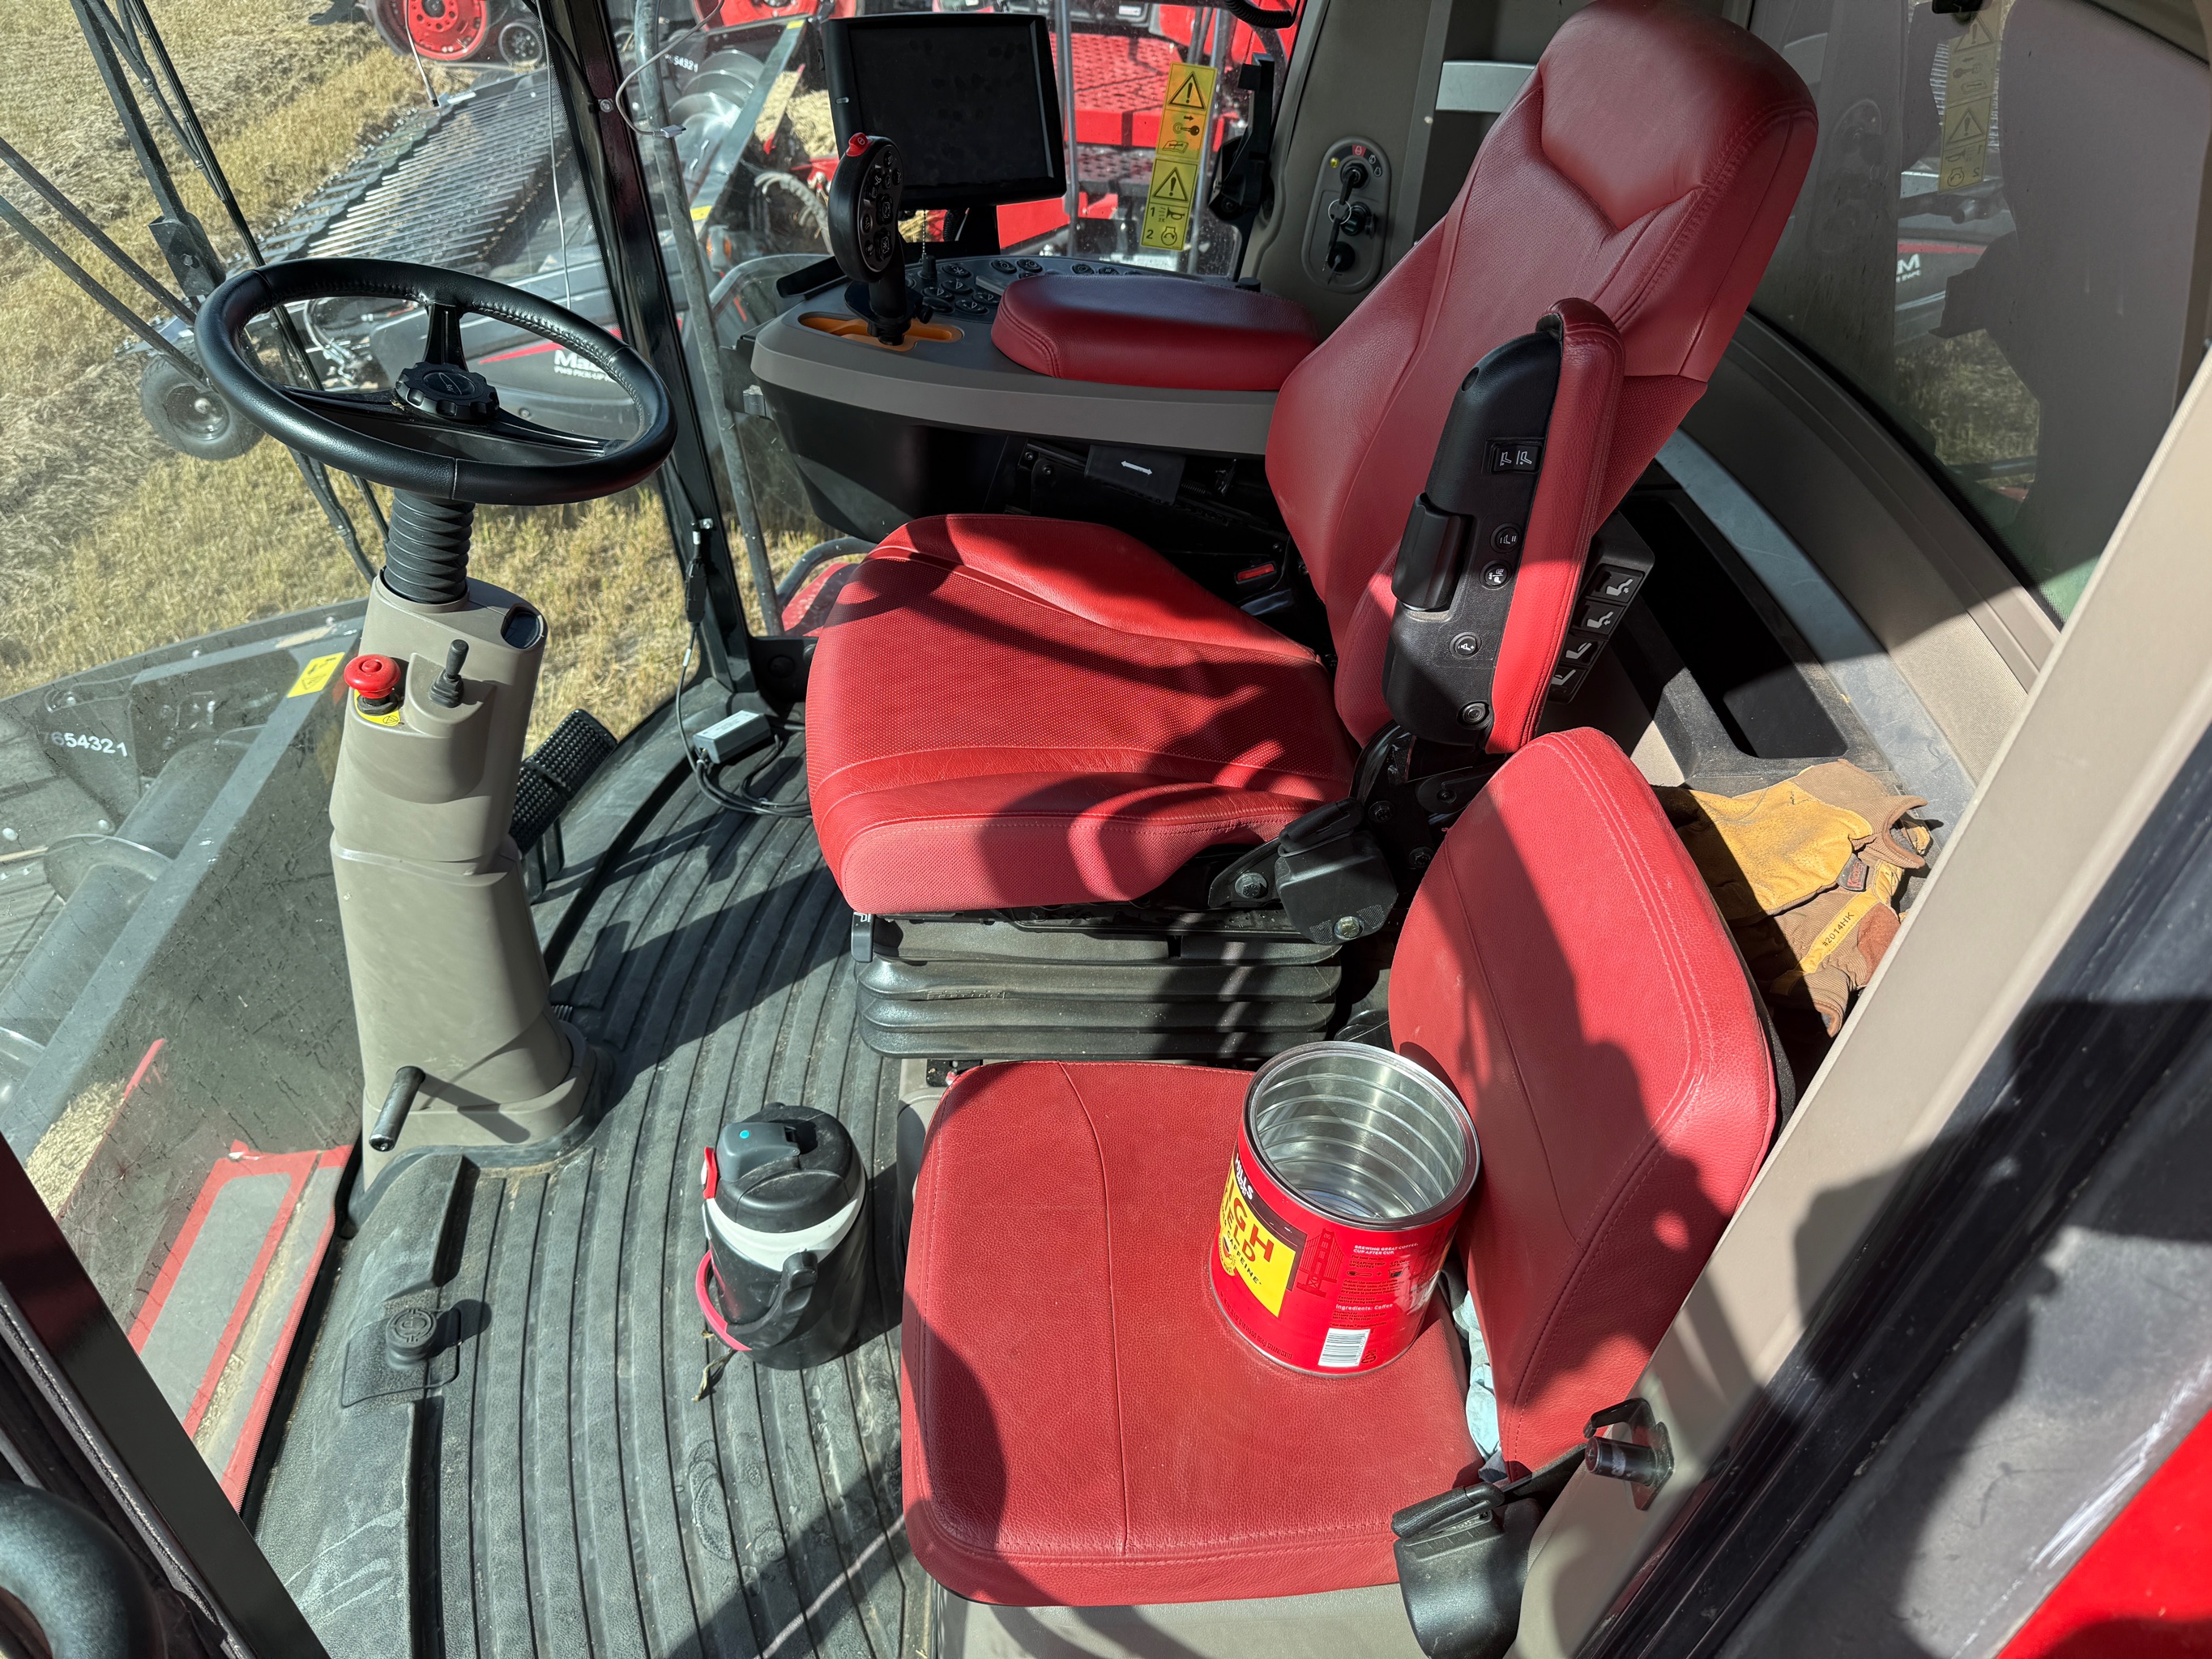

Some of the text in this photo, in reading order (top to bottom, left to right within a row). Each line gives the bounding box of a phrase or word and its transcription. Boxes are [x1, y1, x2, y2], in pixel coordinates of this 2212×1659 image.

[1150, 207, 1155, 217] 1
[1146, 229, 1154, 240] 2
[1235, 1152, 1254, 1201] HILLS
[1335, 1303, 1373, 1311] Ingredients:
